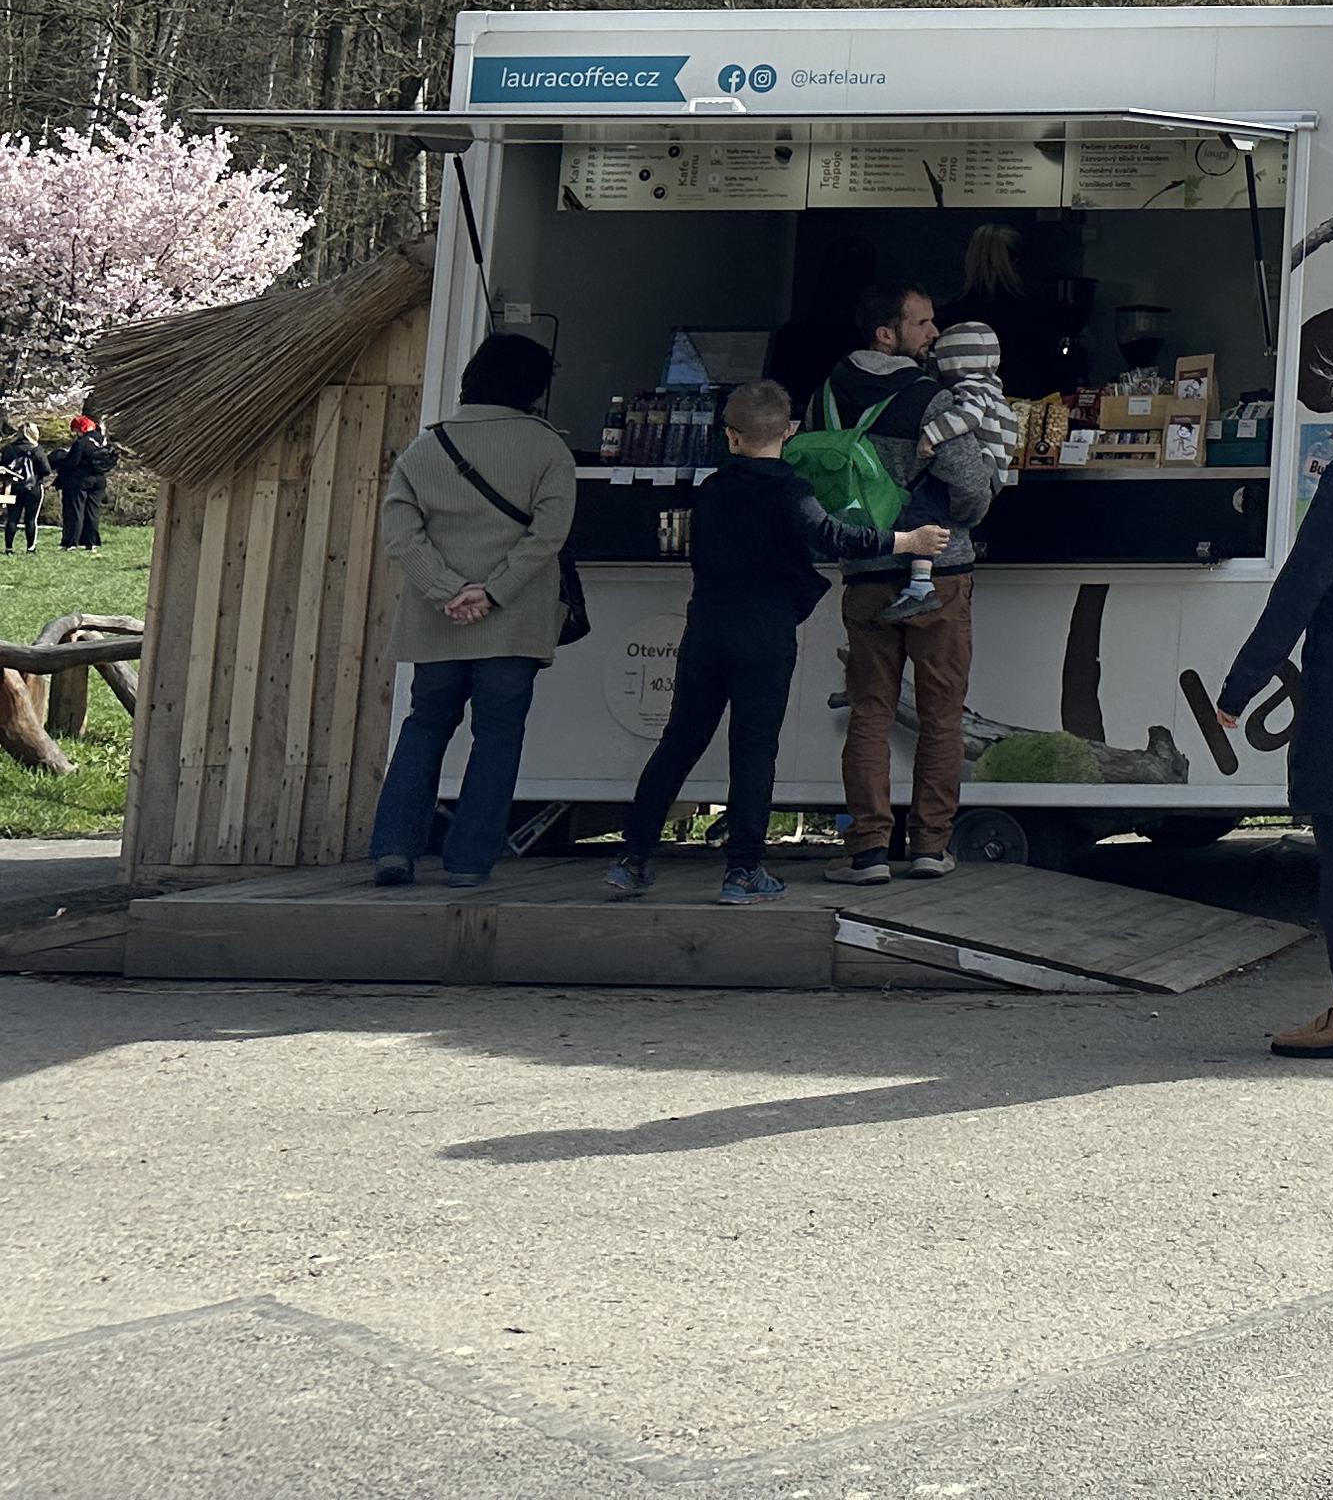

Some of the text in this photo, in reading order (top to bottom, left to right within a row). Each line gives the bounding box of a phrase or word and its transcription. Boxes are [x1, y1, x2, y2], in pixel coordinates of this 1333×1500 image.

[500, 66, 660, 91] lauracoffee.cz
[790, 69, 887, 89] @kafelaura
[569, 157, 581, 185] Kafe
[678, 159, 690, 187] Kafe
[690, 154, 700, 187] menu
[819, 158, 832, 190] Teplé
[937, 155, 948, 182] Kafe
[949, 155, 959, 182] zrno
[1309, 460, 1328, 476] Bu
[626, 642, 679, 658] Otevře
